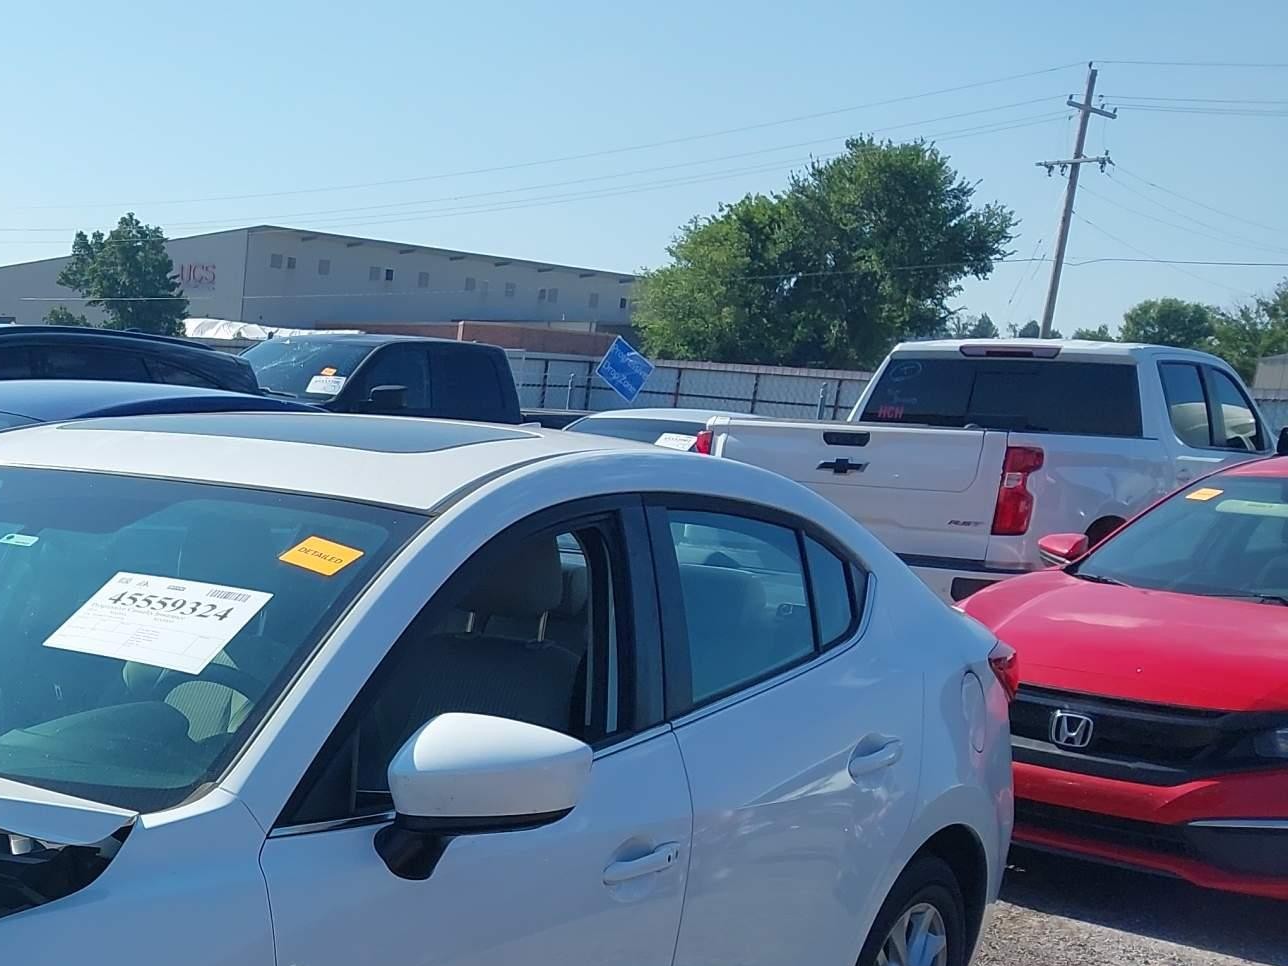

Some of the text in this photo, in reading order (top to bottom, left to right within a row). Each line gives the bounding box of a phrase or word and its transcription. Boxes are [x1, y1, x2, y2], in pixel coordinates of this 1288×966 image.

[602, 360, 637, 393] Drop Zone
[297, 546, 344, 564] DETAILED
[108, 591, 235, 621] 45559324
